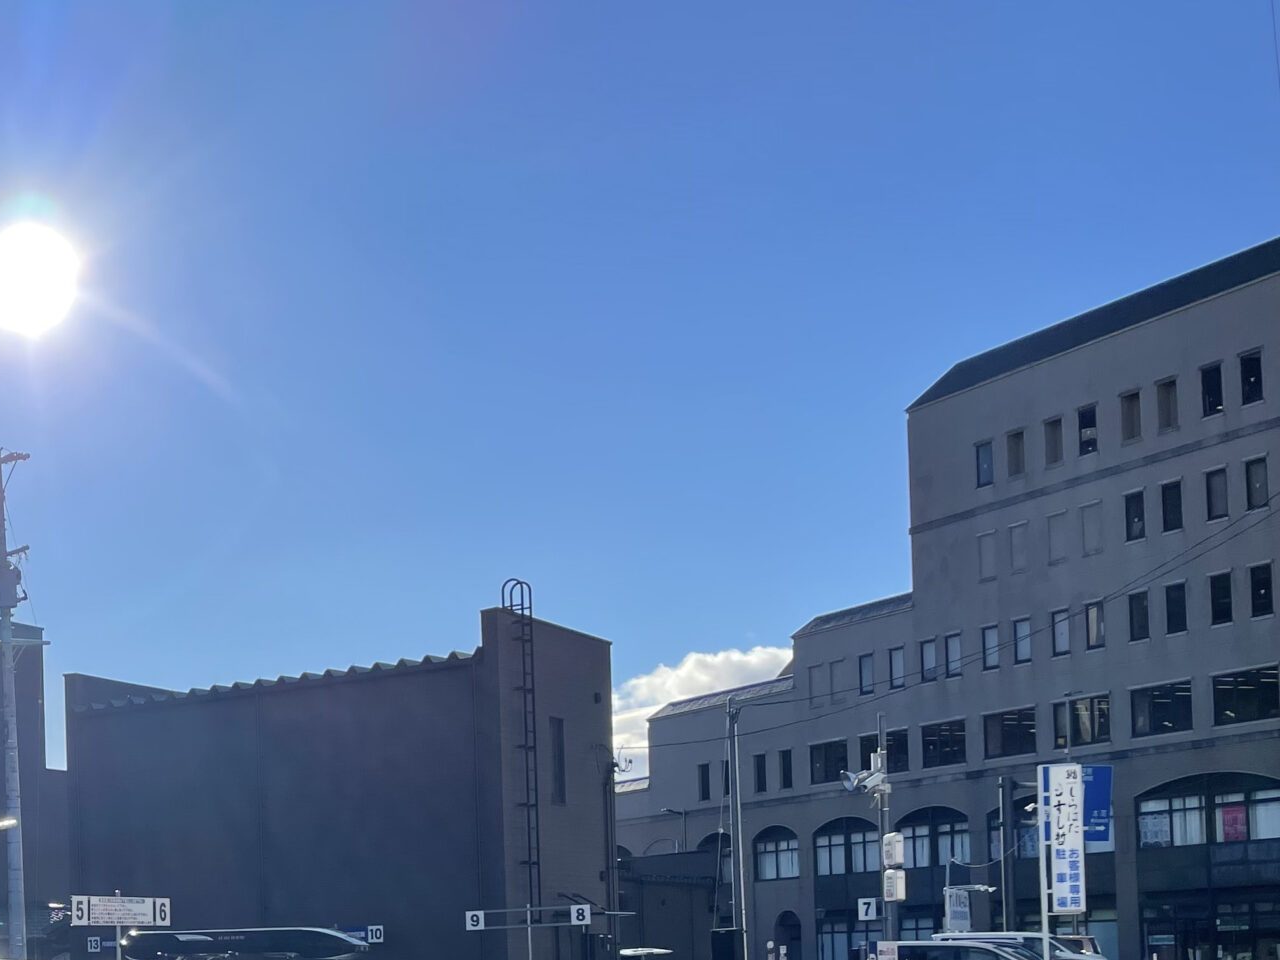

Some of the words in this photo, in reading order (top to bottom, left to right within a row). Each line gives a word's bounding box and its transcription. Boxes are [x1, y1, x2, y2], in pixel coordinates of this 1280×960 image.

[76, 901, 84, 920] 5
[159, 903, 167, 921] 6
[576, 908, 585, 921] 8
[862, 902, 871, 917] 7
[470, 914, 480, 926] 9
[370, 928, 382, 939] 10
[88, 939, 99, 950] 13
